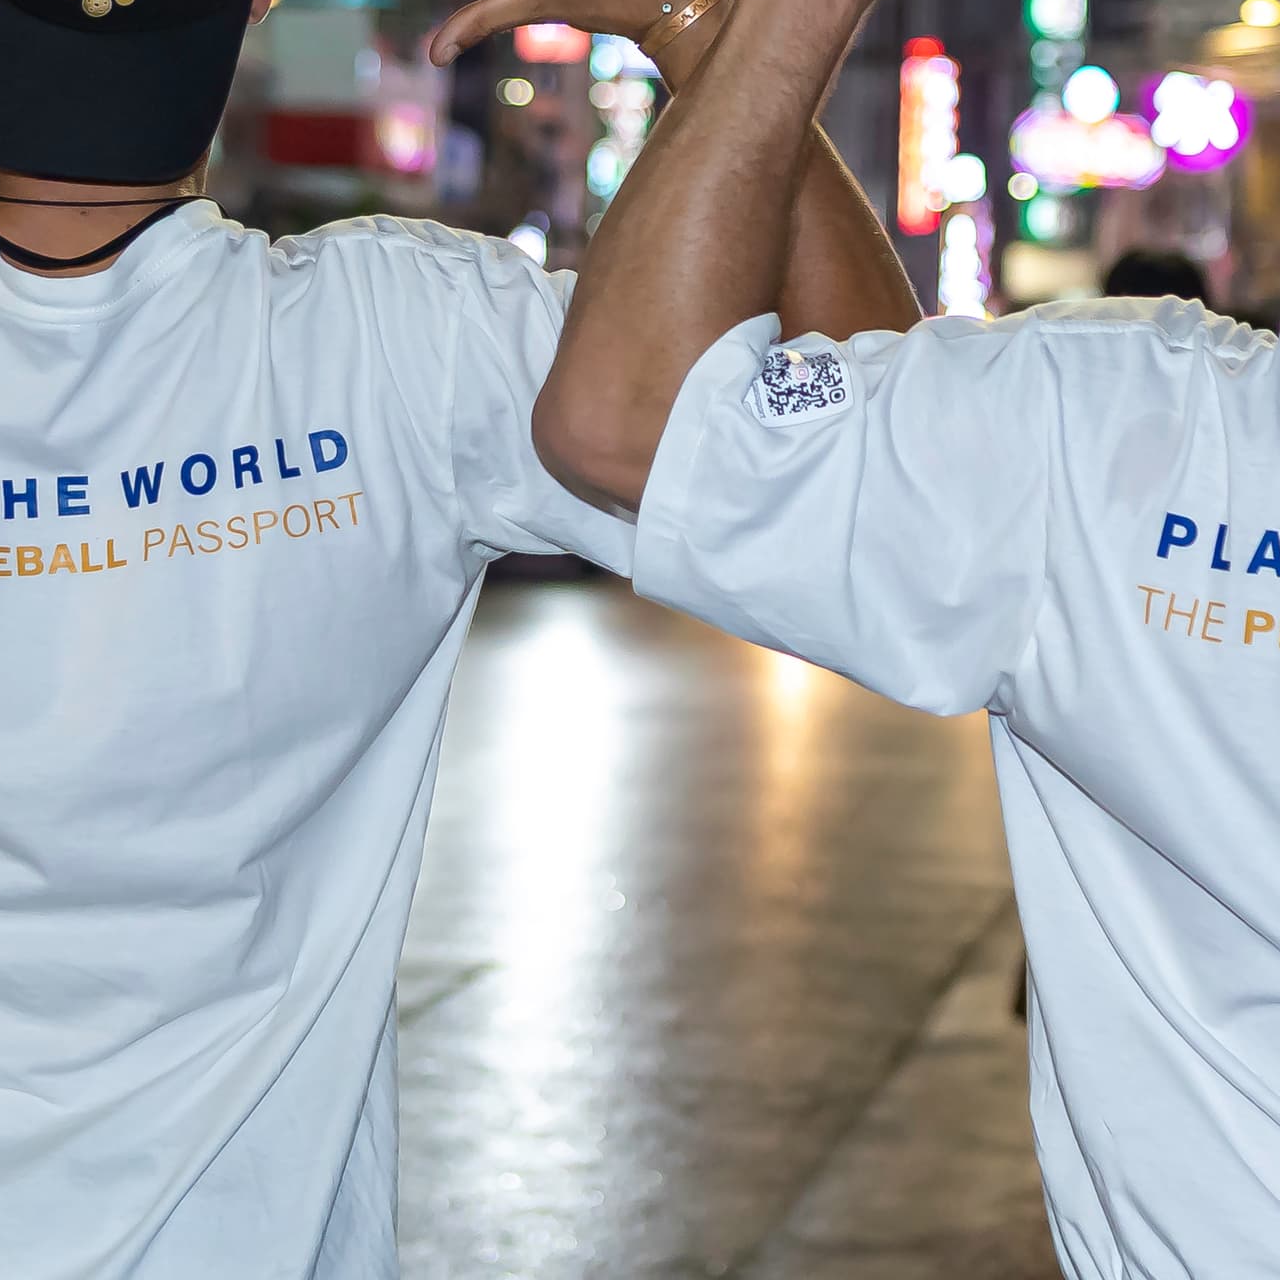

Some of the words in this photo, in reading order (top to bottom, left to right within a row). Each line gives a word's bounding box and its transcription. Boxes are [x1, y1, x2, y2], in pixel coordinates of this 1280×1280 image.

[120, 428, 350, 509] WORLD
[142, 490, 365, 562] PASSPORT
[1136, 585, 1227, 644] THE
